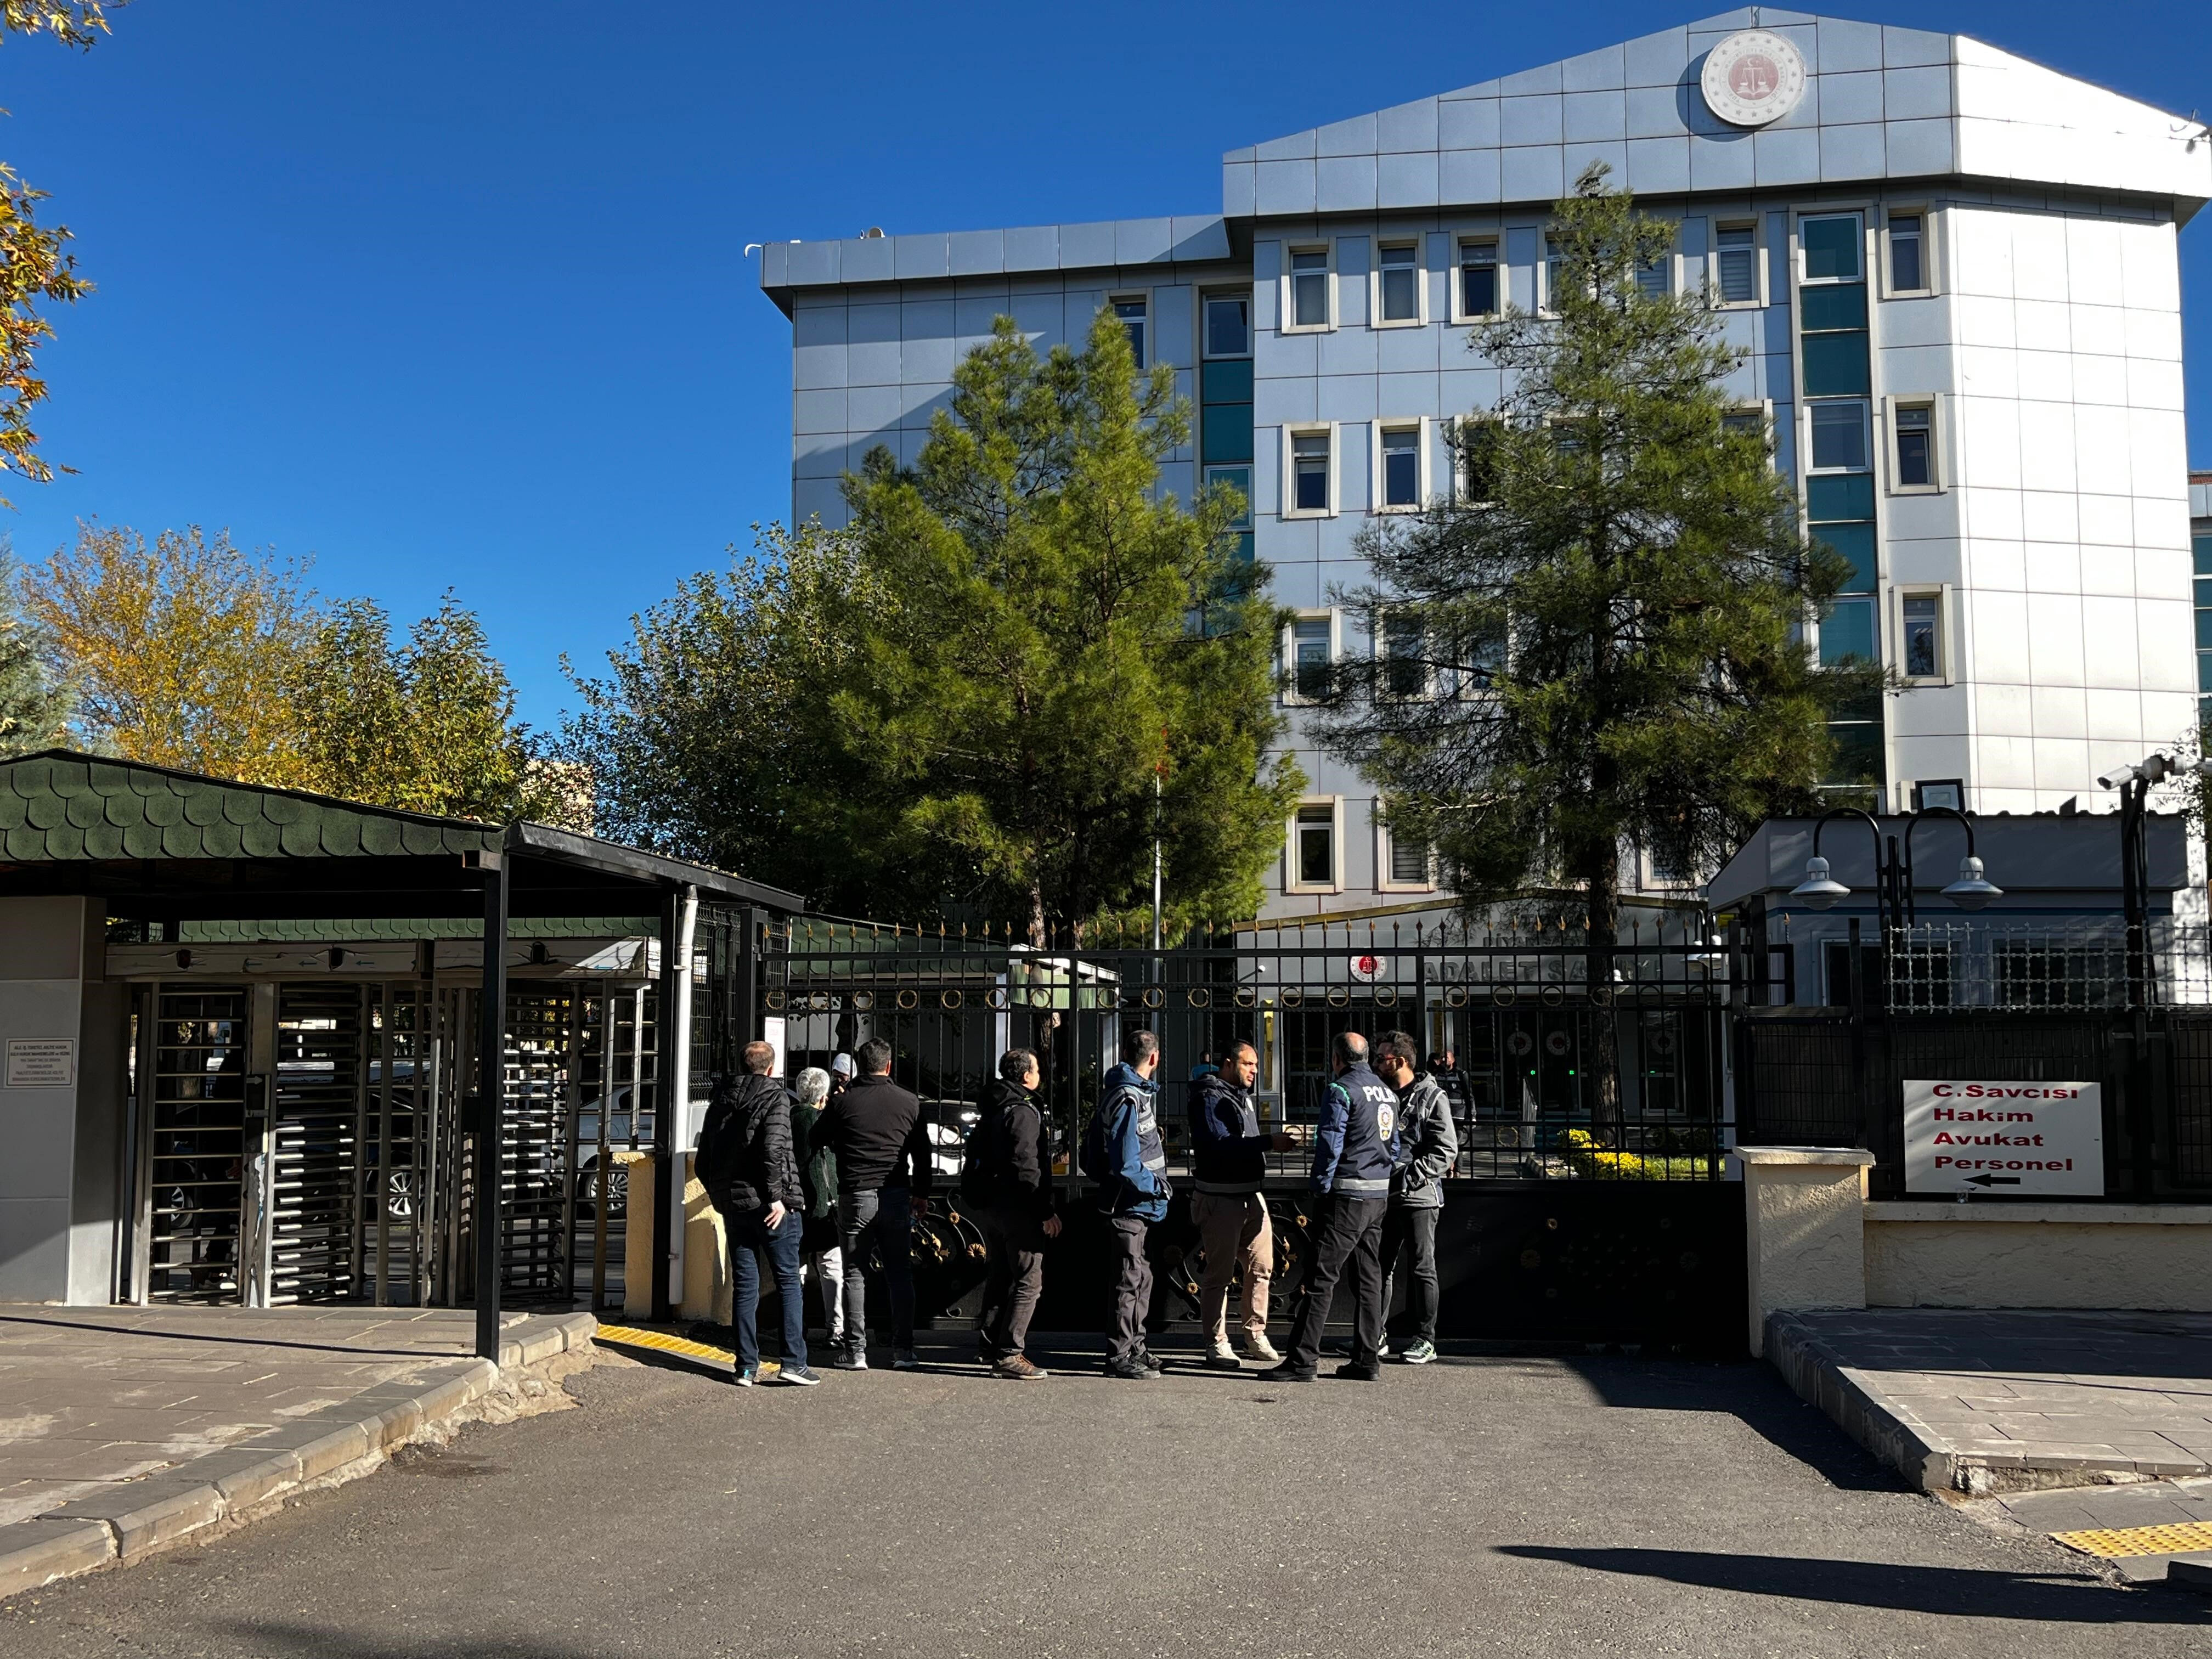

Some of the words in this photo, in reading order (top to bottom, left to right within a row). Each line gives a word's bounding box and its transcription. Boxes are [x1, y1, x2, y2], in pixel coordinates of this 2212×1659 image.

[1423, 961, 1538, 982] ADALET
[1934, 1108, 2034, 1122] Hakim
[1933, 1132, 2044, 1147] Avukat
[1935, 1156, 2072, 1171] Personel
